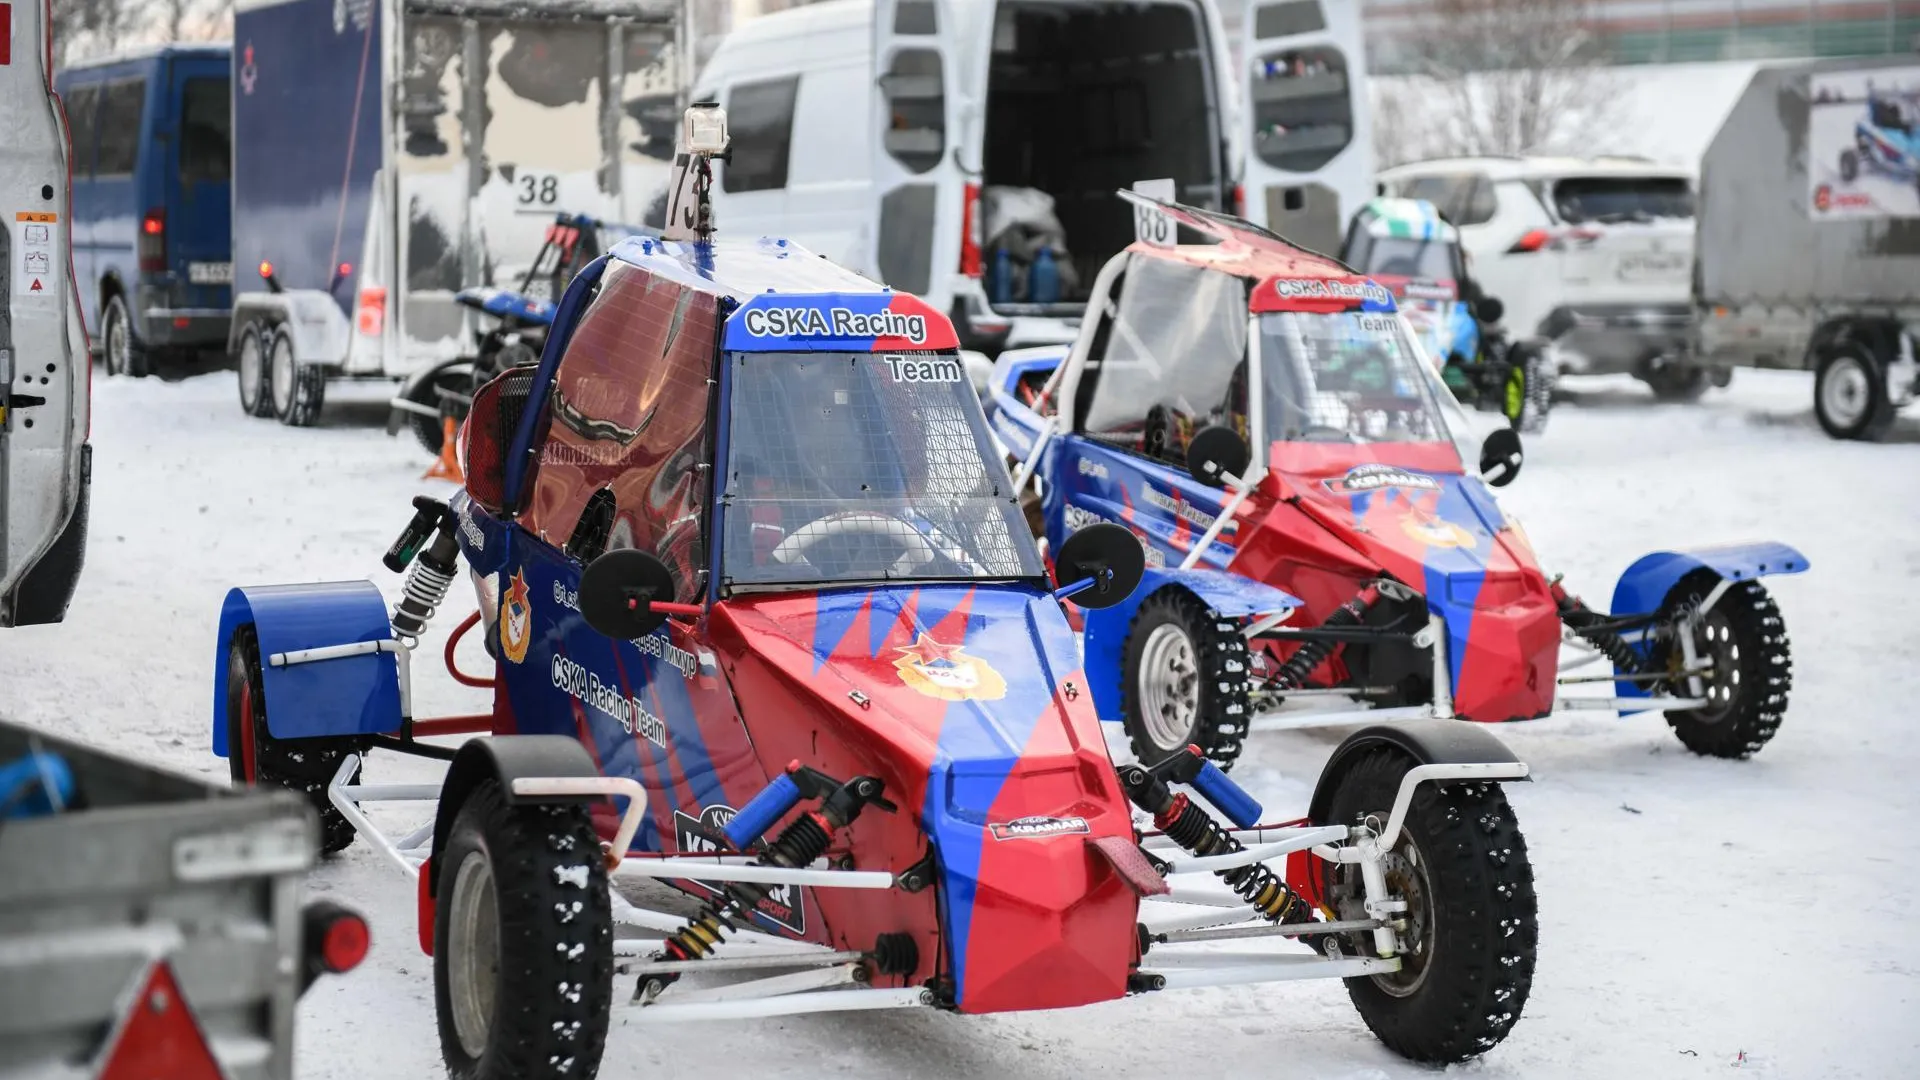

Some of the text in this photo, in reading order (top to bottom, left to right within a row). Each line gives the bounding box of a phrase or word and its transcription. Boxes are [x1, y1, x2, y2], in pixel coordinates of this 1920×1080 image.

[518, 174, 557, 204] 38
[1275, 280, 1327, 297] CSKA
[1329, 280, 1389, 306] Racing
[745, 307, 926, 345] CSKA Racing
[1354, 314, 1398, 333] Team
[885, 355, 962, 383] Team
[660, 634, 697, 680] Тимур
[552, 654, 666, 748] CSKA Racing Team
[1010, 819, 1085, 833] KRAMAR
